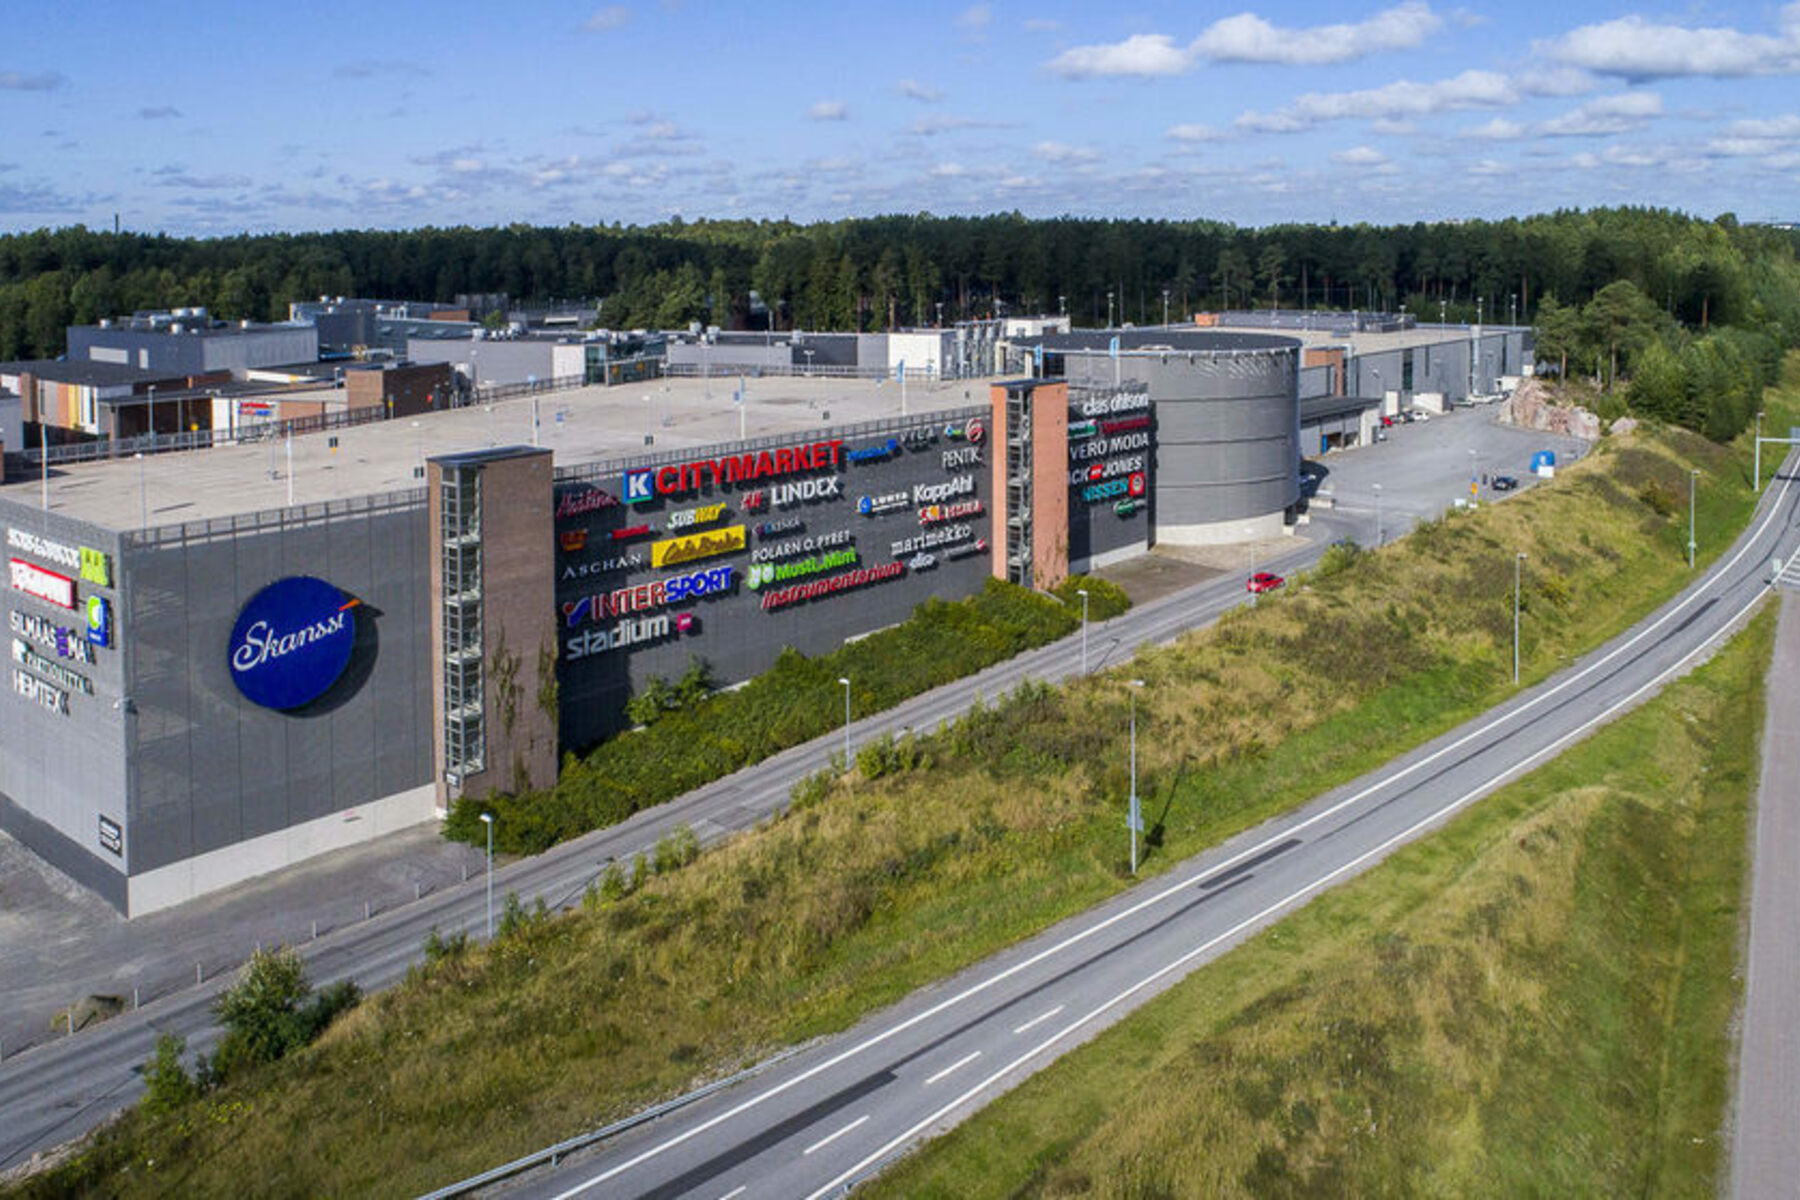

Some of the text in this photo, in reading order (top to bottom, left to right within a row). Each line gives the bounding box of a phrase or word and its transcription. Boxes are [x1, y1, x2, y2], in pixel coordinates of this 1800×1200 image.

[1070, 432, 1150, 460] VERO MODA
[656, 440, 843, 494] CITYMARKET
[1103, 456, 1142, 478] JONES
[629, 473, 651, 498] K
[771, 476, 839, 506] LINDEX
[913, 475, 973, 503] KappAhl
[667, 502, 727, 530] SUBWAY
[752, 541, 800, 563] POLARN
[891, 523, 971, 556] marimekko
[592, 565, 735, 621] INTERSPORT
[233, 611, 344, 671] Skanssi
[566, 614, 669, 661] stadium
